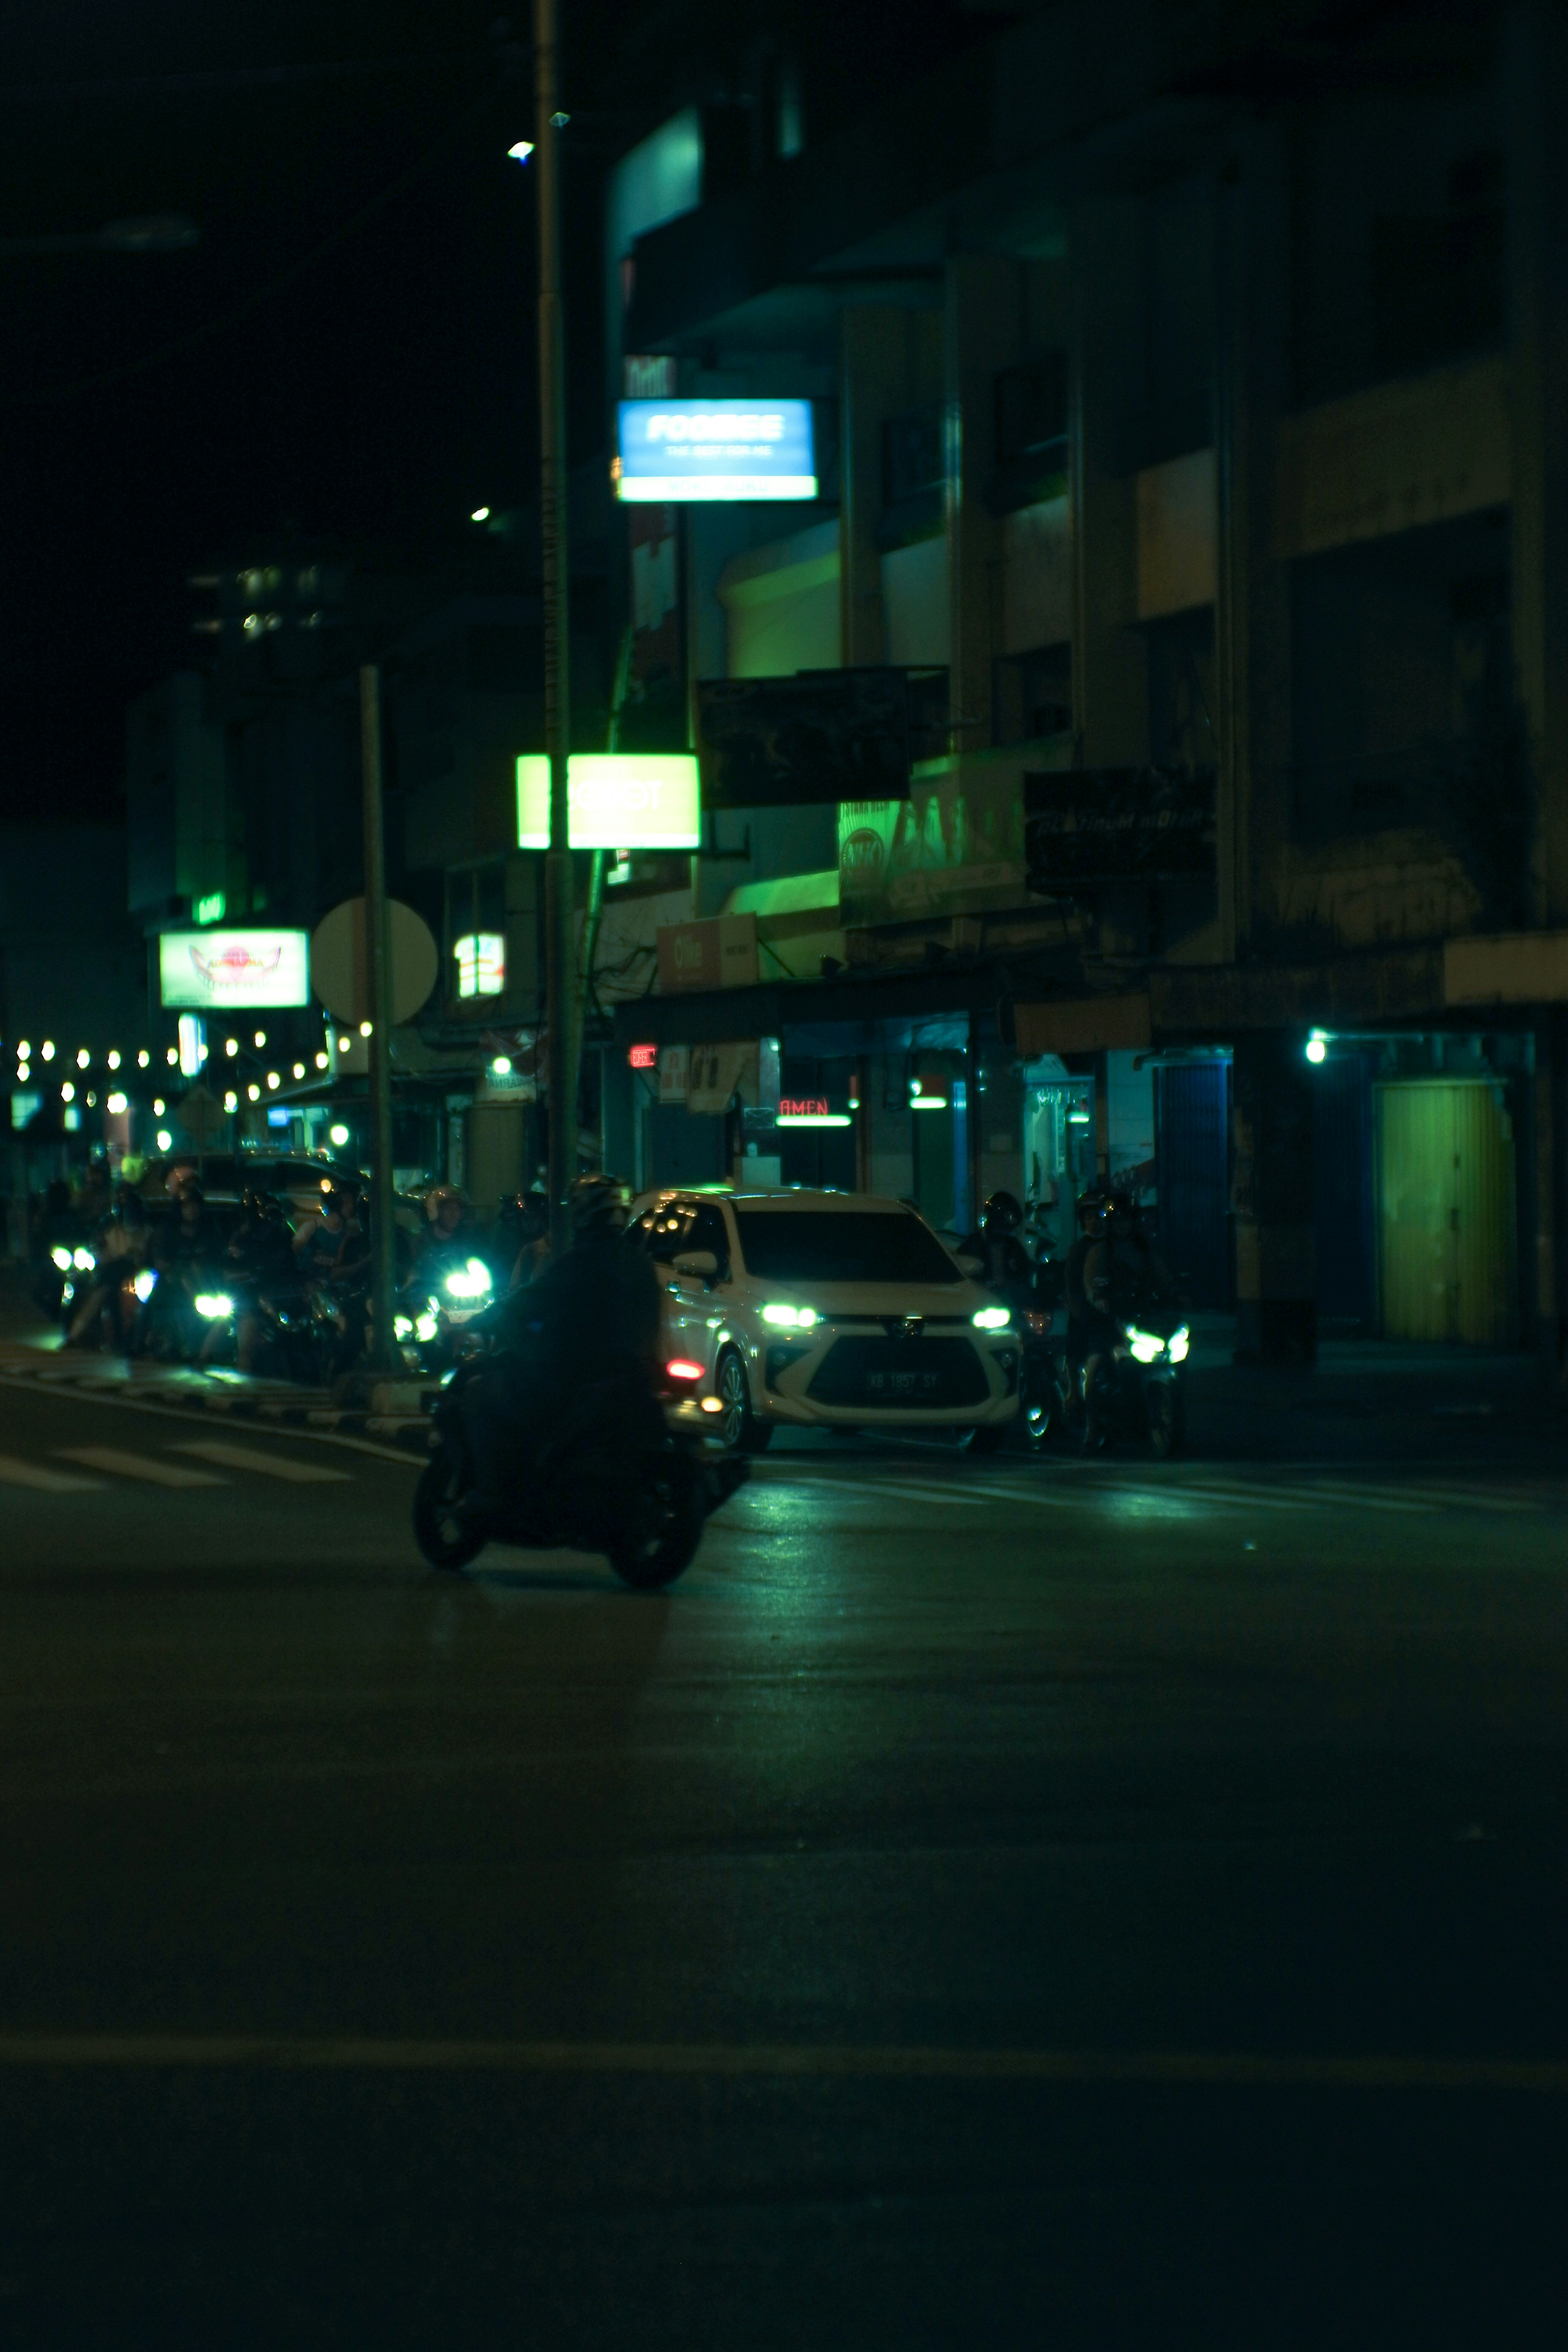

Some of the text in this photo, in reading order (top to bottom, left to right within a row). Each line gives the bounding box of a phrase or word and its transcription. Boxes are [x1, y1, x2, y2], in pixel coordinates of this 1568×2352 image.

[666, 445, 689, 456] THE
[727, 445, 749, 455] FOR
[754, 445, 772, 455] ME
